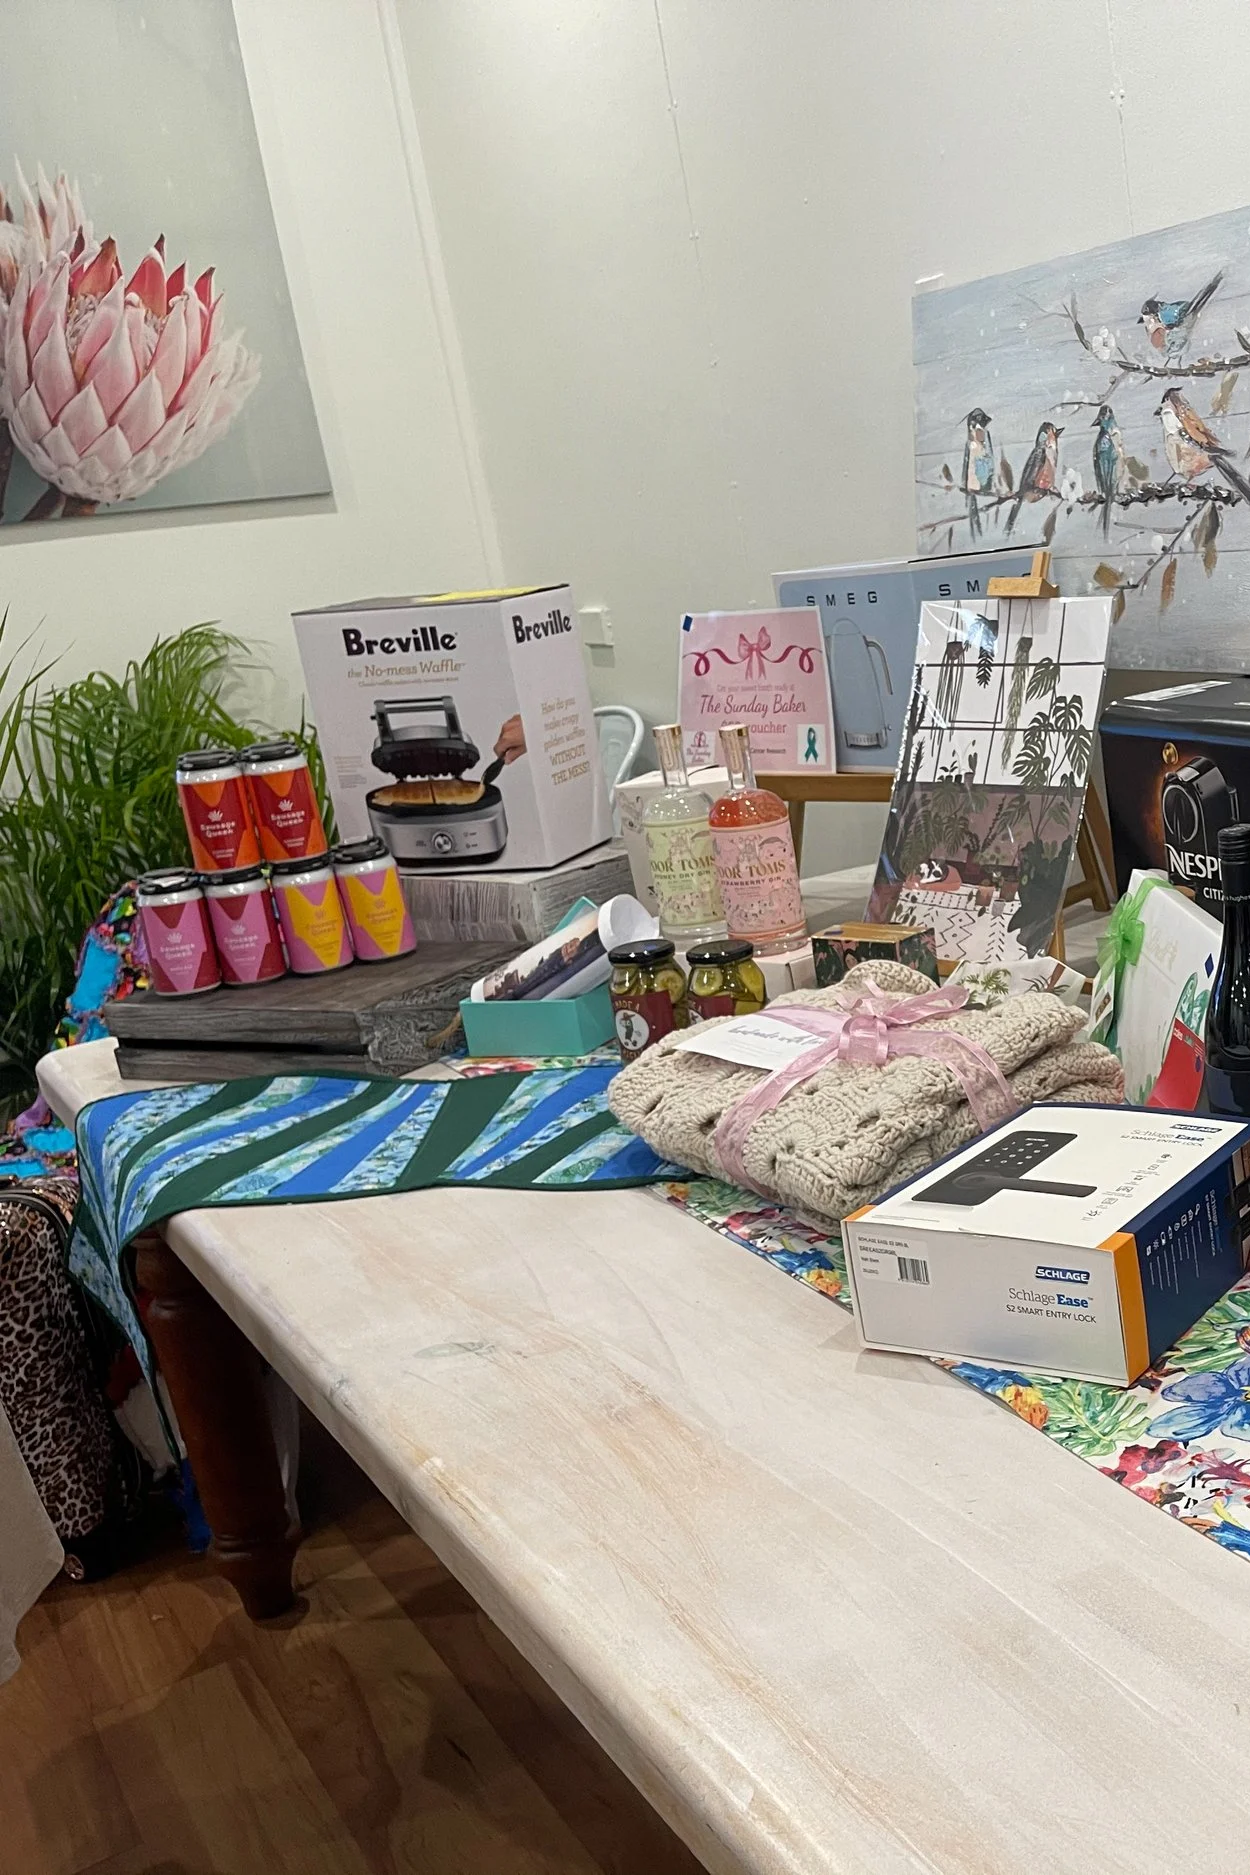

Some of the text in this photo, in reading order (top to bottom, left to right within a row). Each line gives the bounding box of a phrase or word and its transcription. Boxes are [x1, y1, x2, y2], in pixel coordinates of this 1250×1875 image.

[806, 590, 878, 607] SMEG
[511, 609, 572, 644] Breville
[342, 625, 457, 656] Breville
[347, 666, 363, 679] the
[418, 658, 461, 673] Waffle
[700, 693, 807, 718] The Sunday Baker
[751, 721, 787, 734] oucher
[550, 744, 586, 766] WITHOUT
[551, 769, 568, 786] THE
[677, 855, 715, 872] TOMS
[745, 858, 786, 877] TOMS
[1037, 1268, 1089, 1282] SCHLAGE
[1008, 1287, 1089, 1308] Schlage Ease
[1006, 1304, 1097, 1324] S2 SMART ENTRY LOCK
